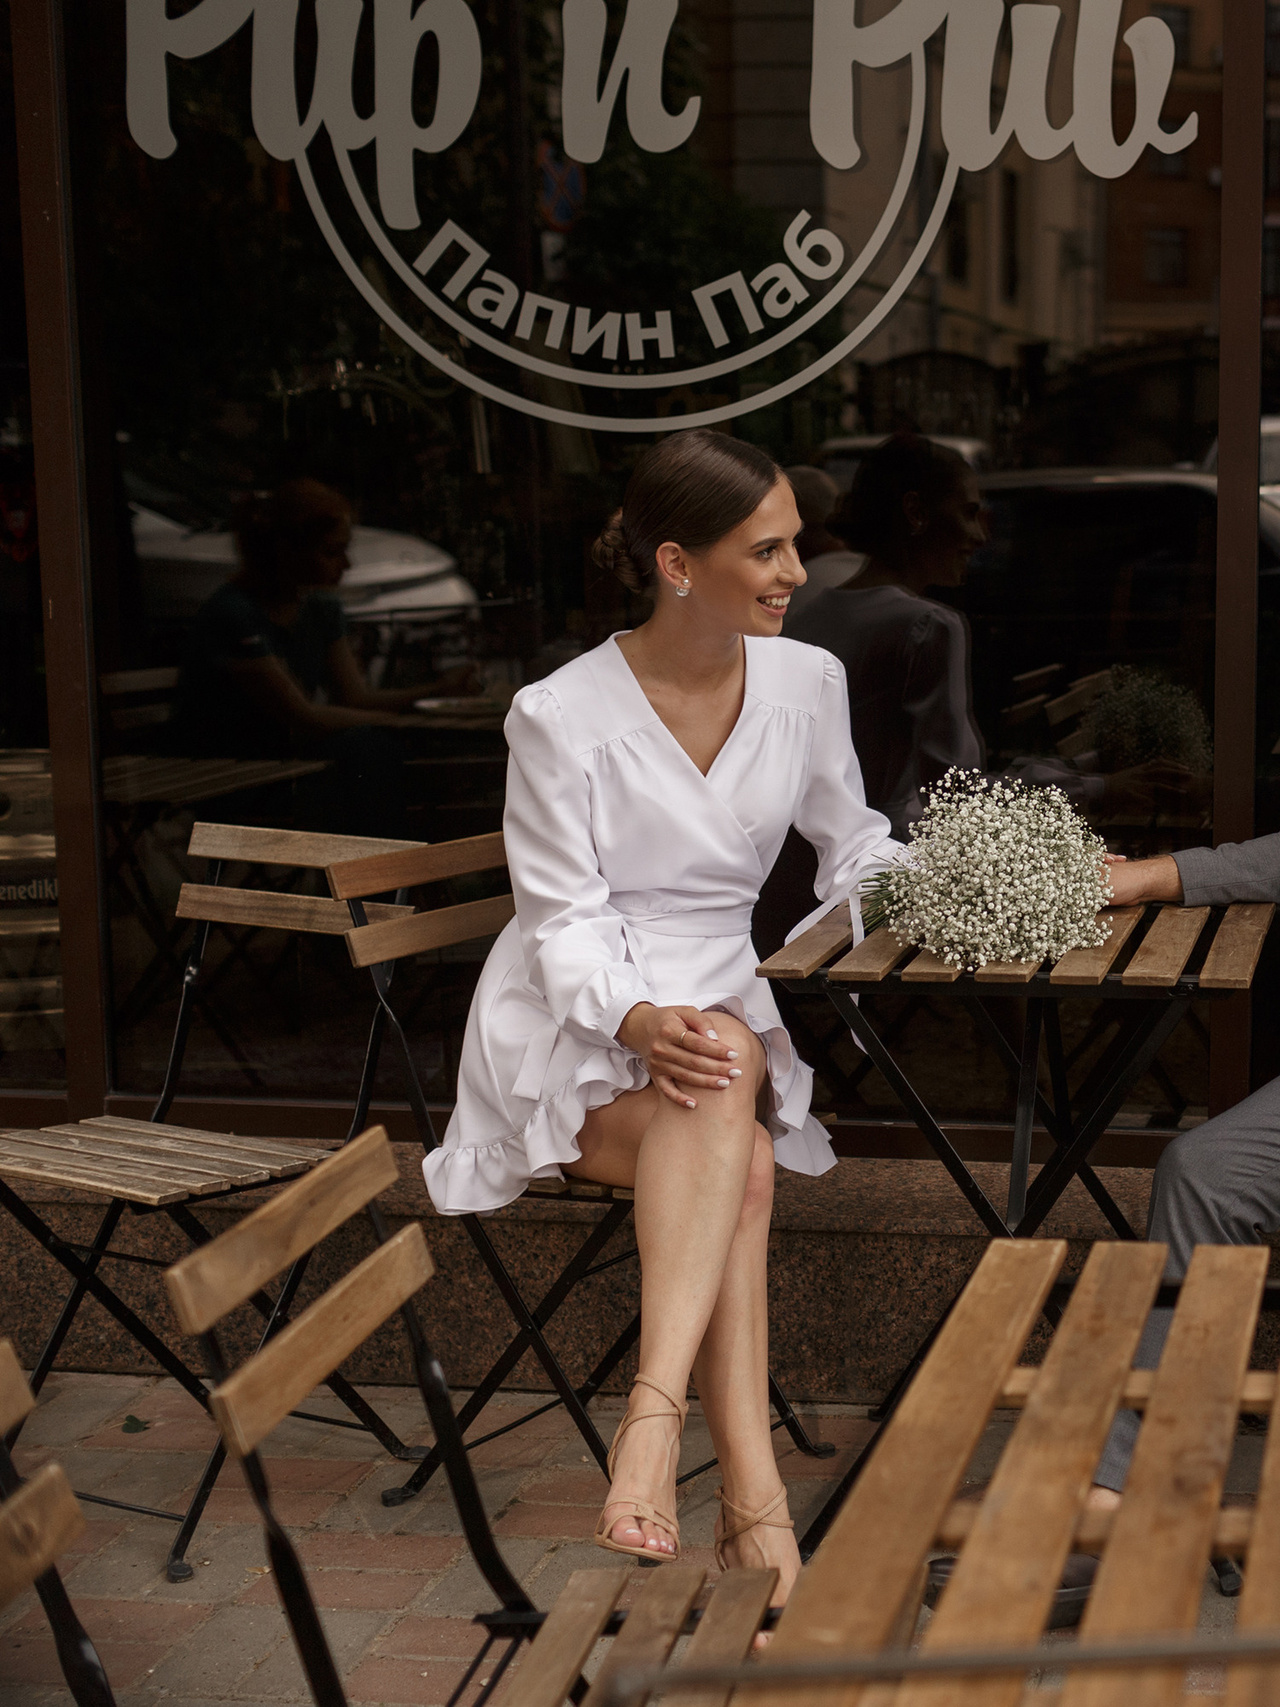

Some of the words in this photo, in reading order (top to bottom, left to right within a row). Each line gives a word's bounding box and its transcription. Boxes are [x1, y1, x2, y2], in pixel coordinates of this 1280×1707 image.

[809, 0, 1199, 179] Pub
[412, 218, 676, 361] Папин
[690, 208, 845, 350] Паб
